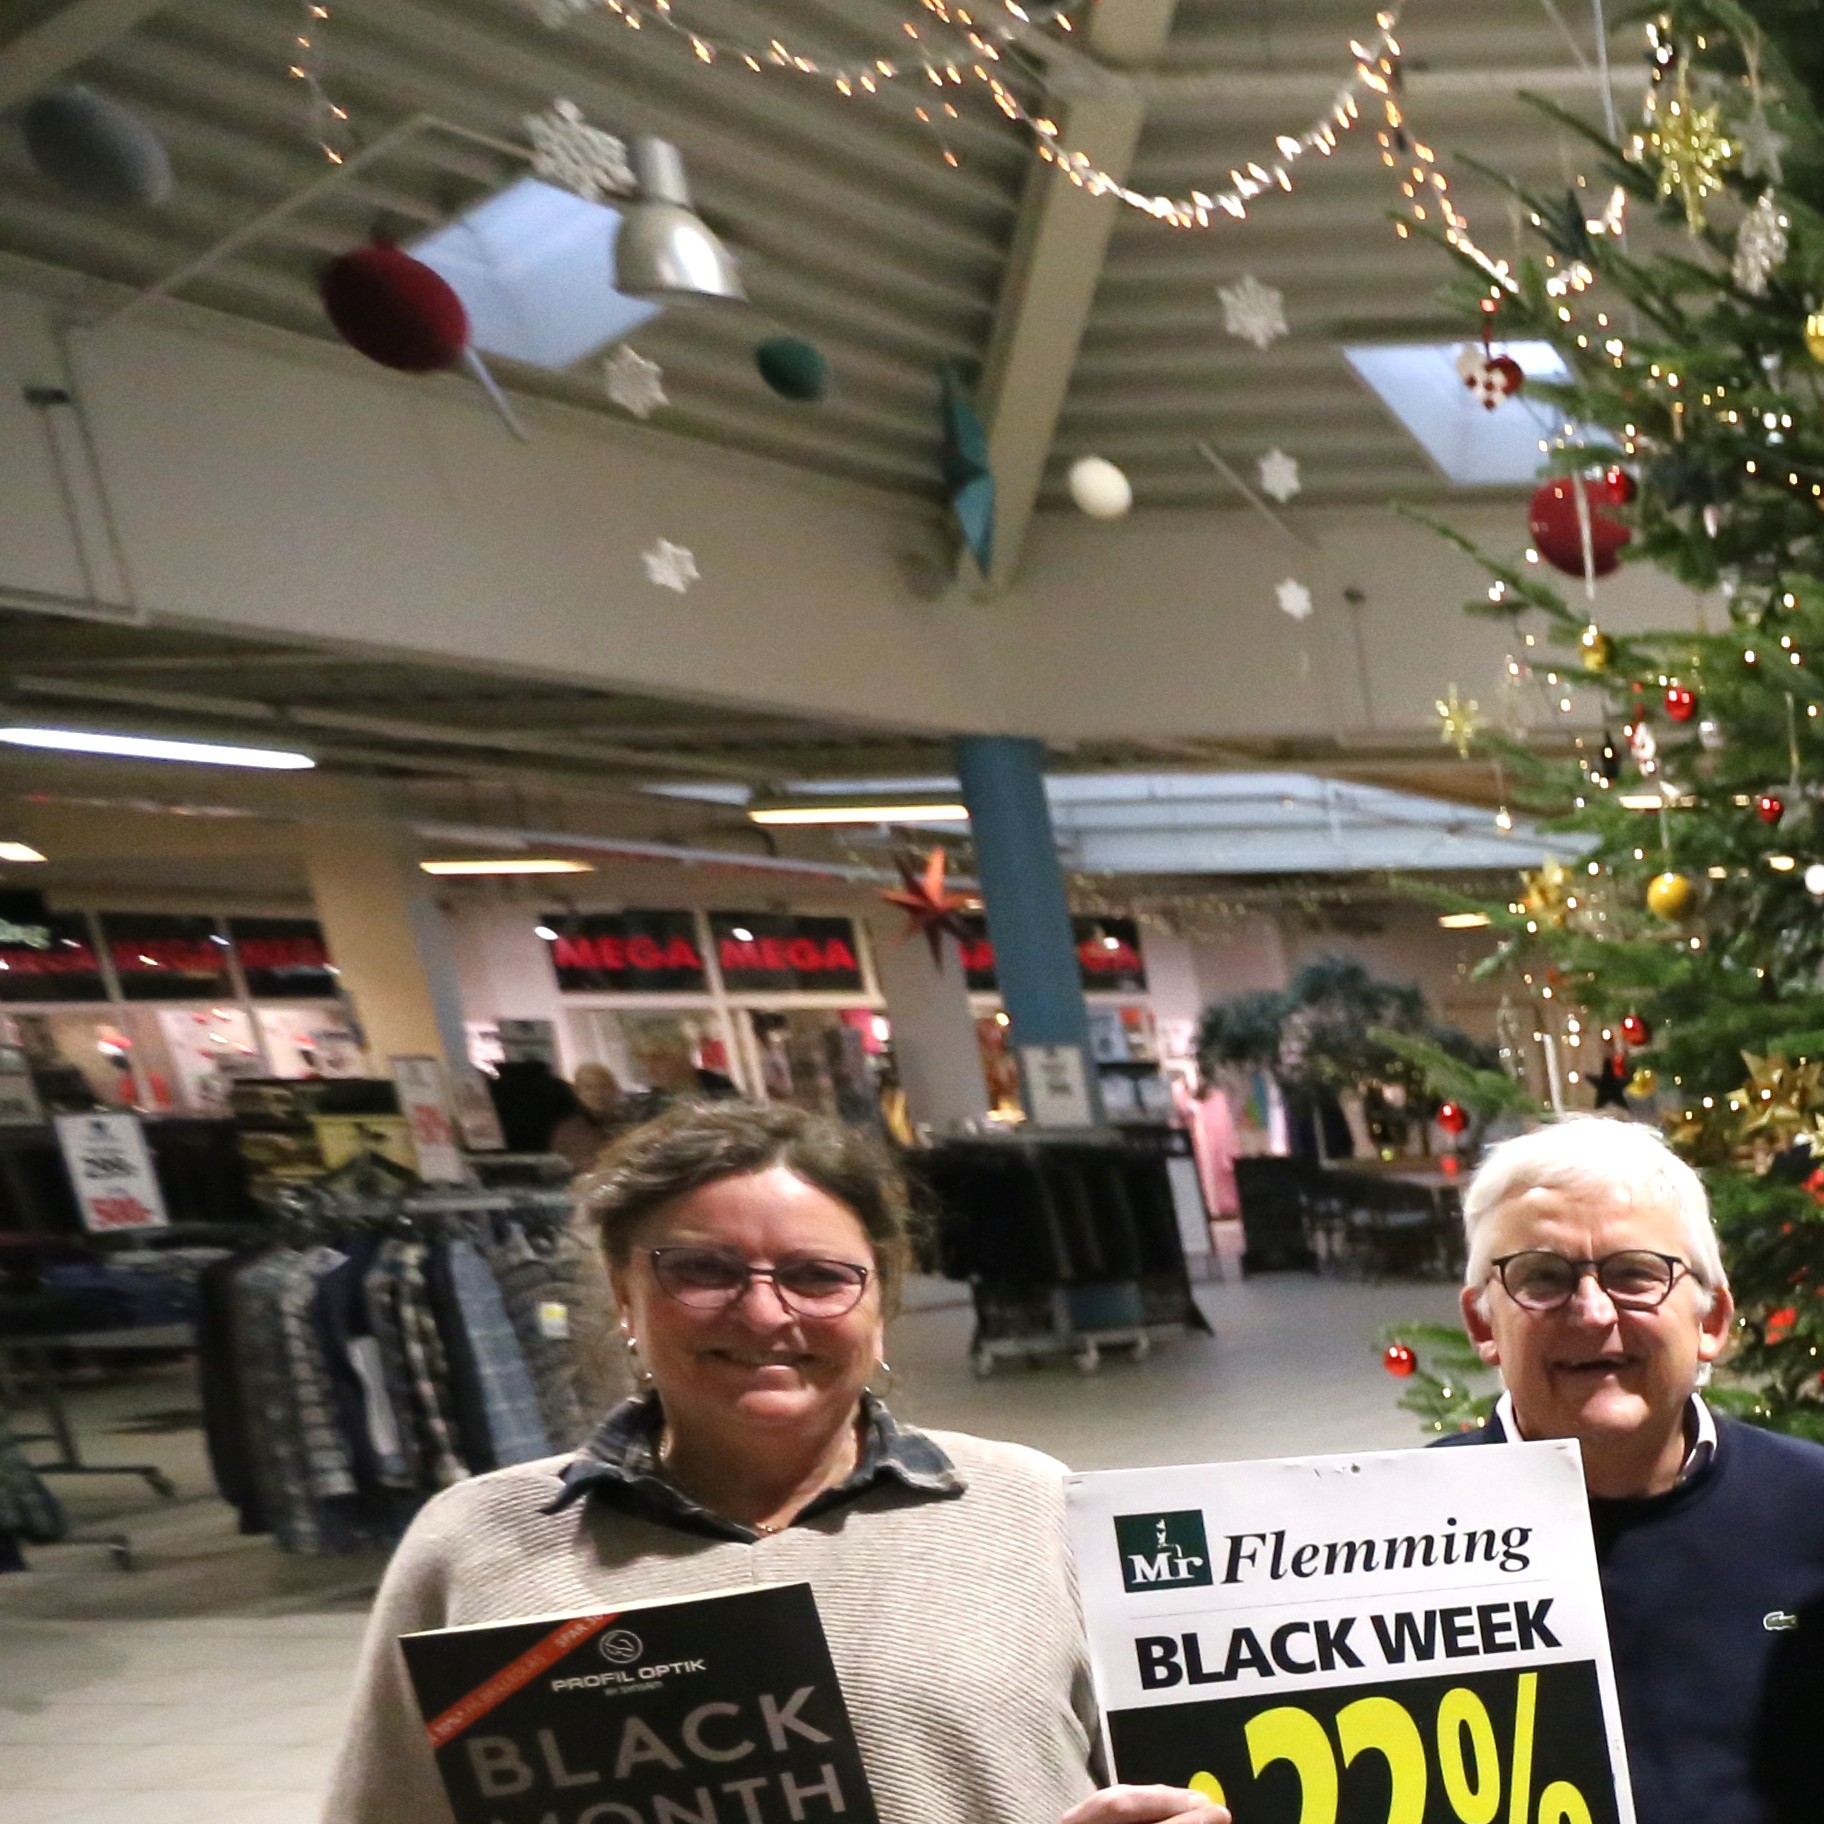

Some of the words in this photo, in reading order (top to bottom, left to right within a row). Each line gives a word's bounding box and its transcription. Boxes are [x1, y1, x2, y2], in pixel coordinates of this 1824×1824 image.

[553, 935, 702, 970] MEGA
[719, 938, 857, 971] MEGA
[1128, 1551, 1205, 1584] Mr
[1223, 1516, 1534, 1586] Flemming
[1135, 1615, 1364, 1690] BLACK
[1370, 1598, 1562, 1665] WEEK
[551, 1669, 634, 1693] PROFIL
[639, 1659, 707, 1680] OPTIK
[465, 1686, 835, 1800] BLACK
